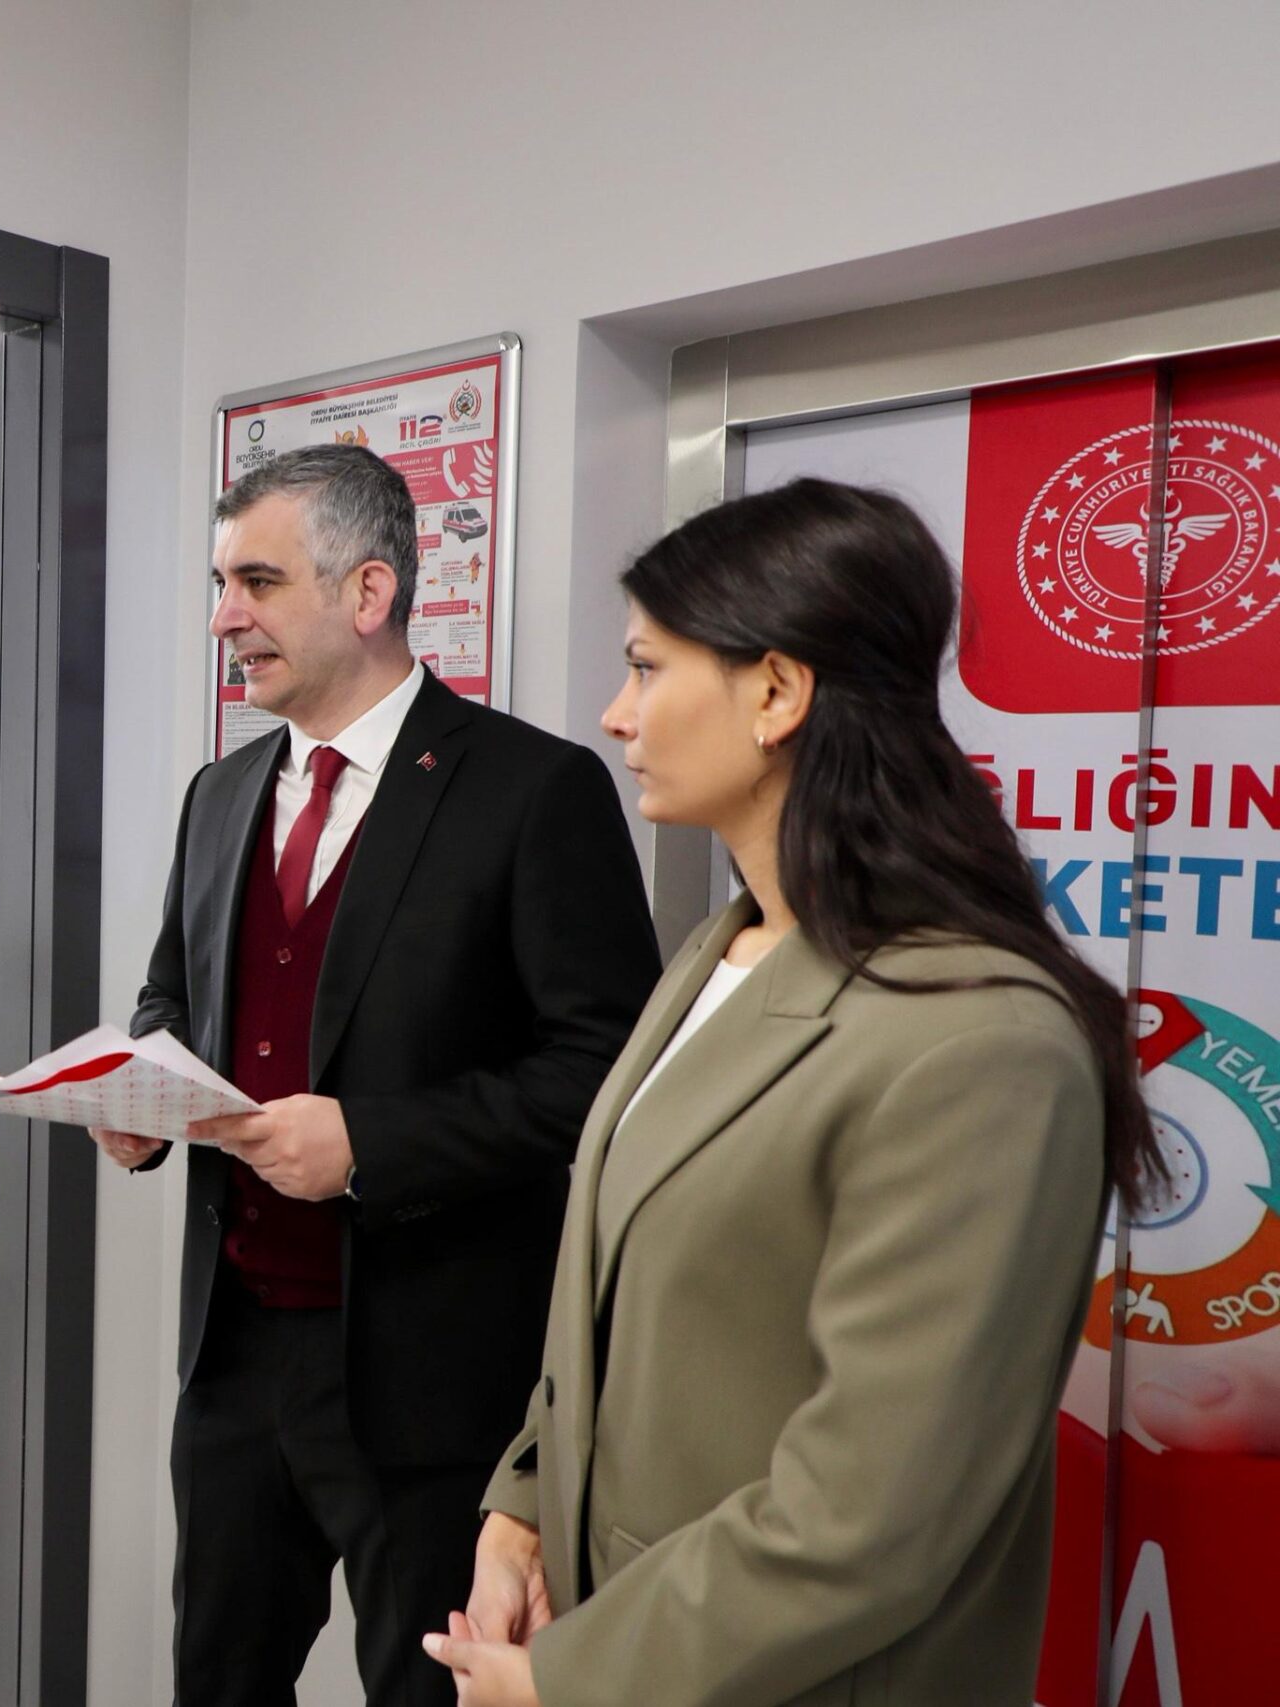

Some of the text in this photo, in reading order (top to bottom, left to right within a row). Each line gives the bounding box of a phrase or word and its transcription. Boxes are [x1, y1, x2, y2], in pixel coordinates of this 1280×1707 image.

[400, 415, 443, 441] 112
[1065, 462, 1259, 610] TÜRKİYE CUMHURİYETİ SAĞLIK BAKANLIĞI
